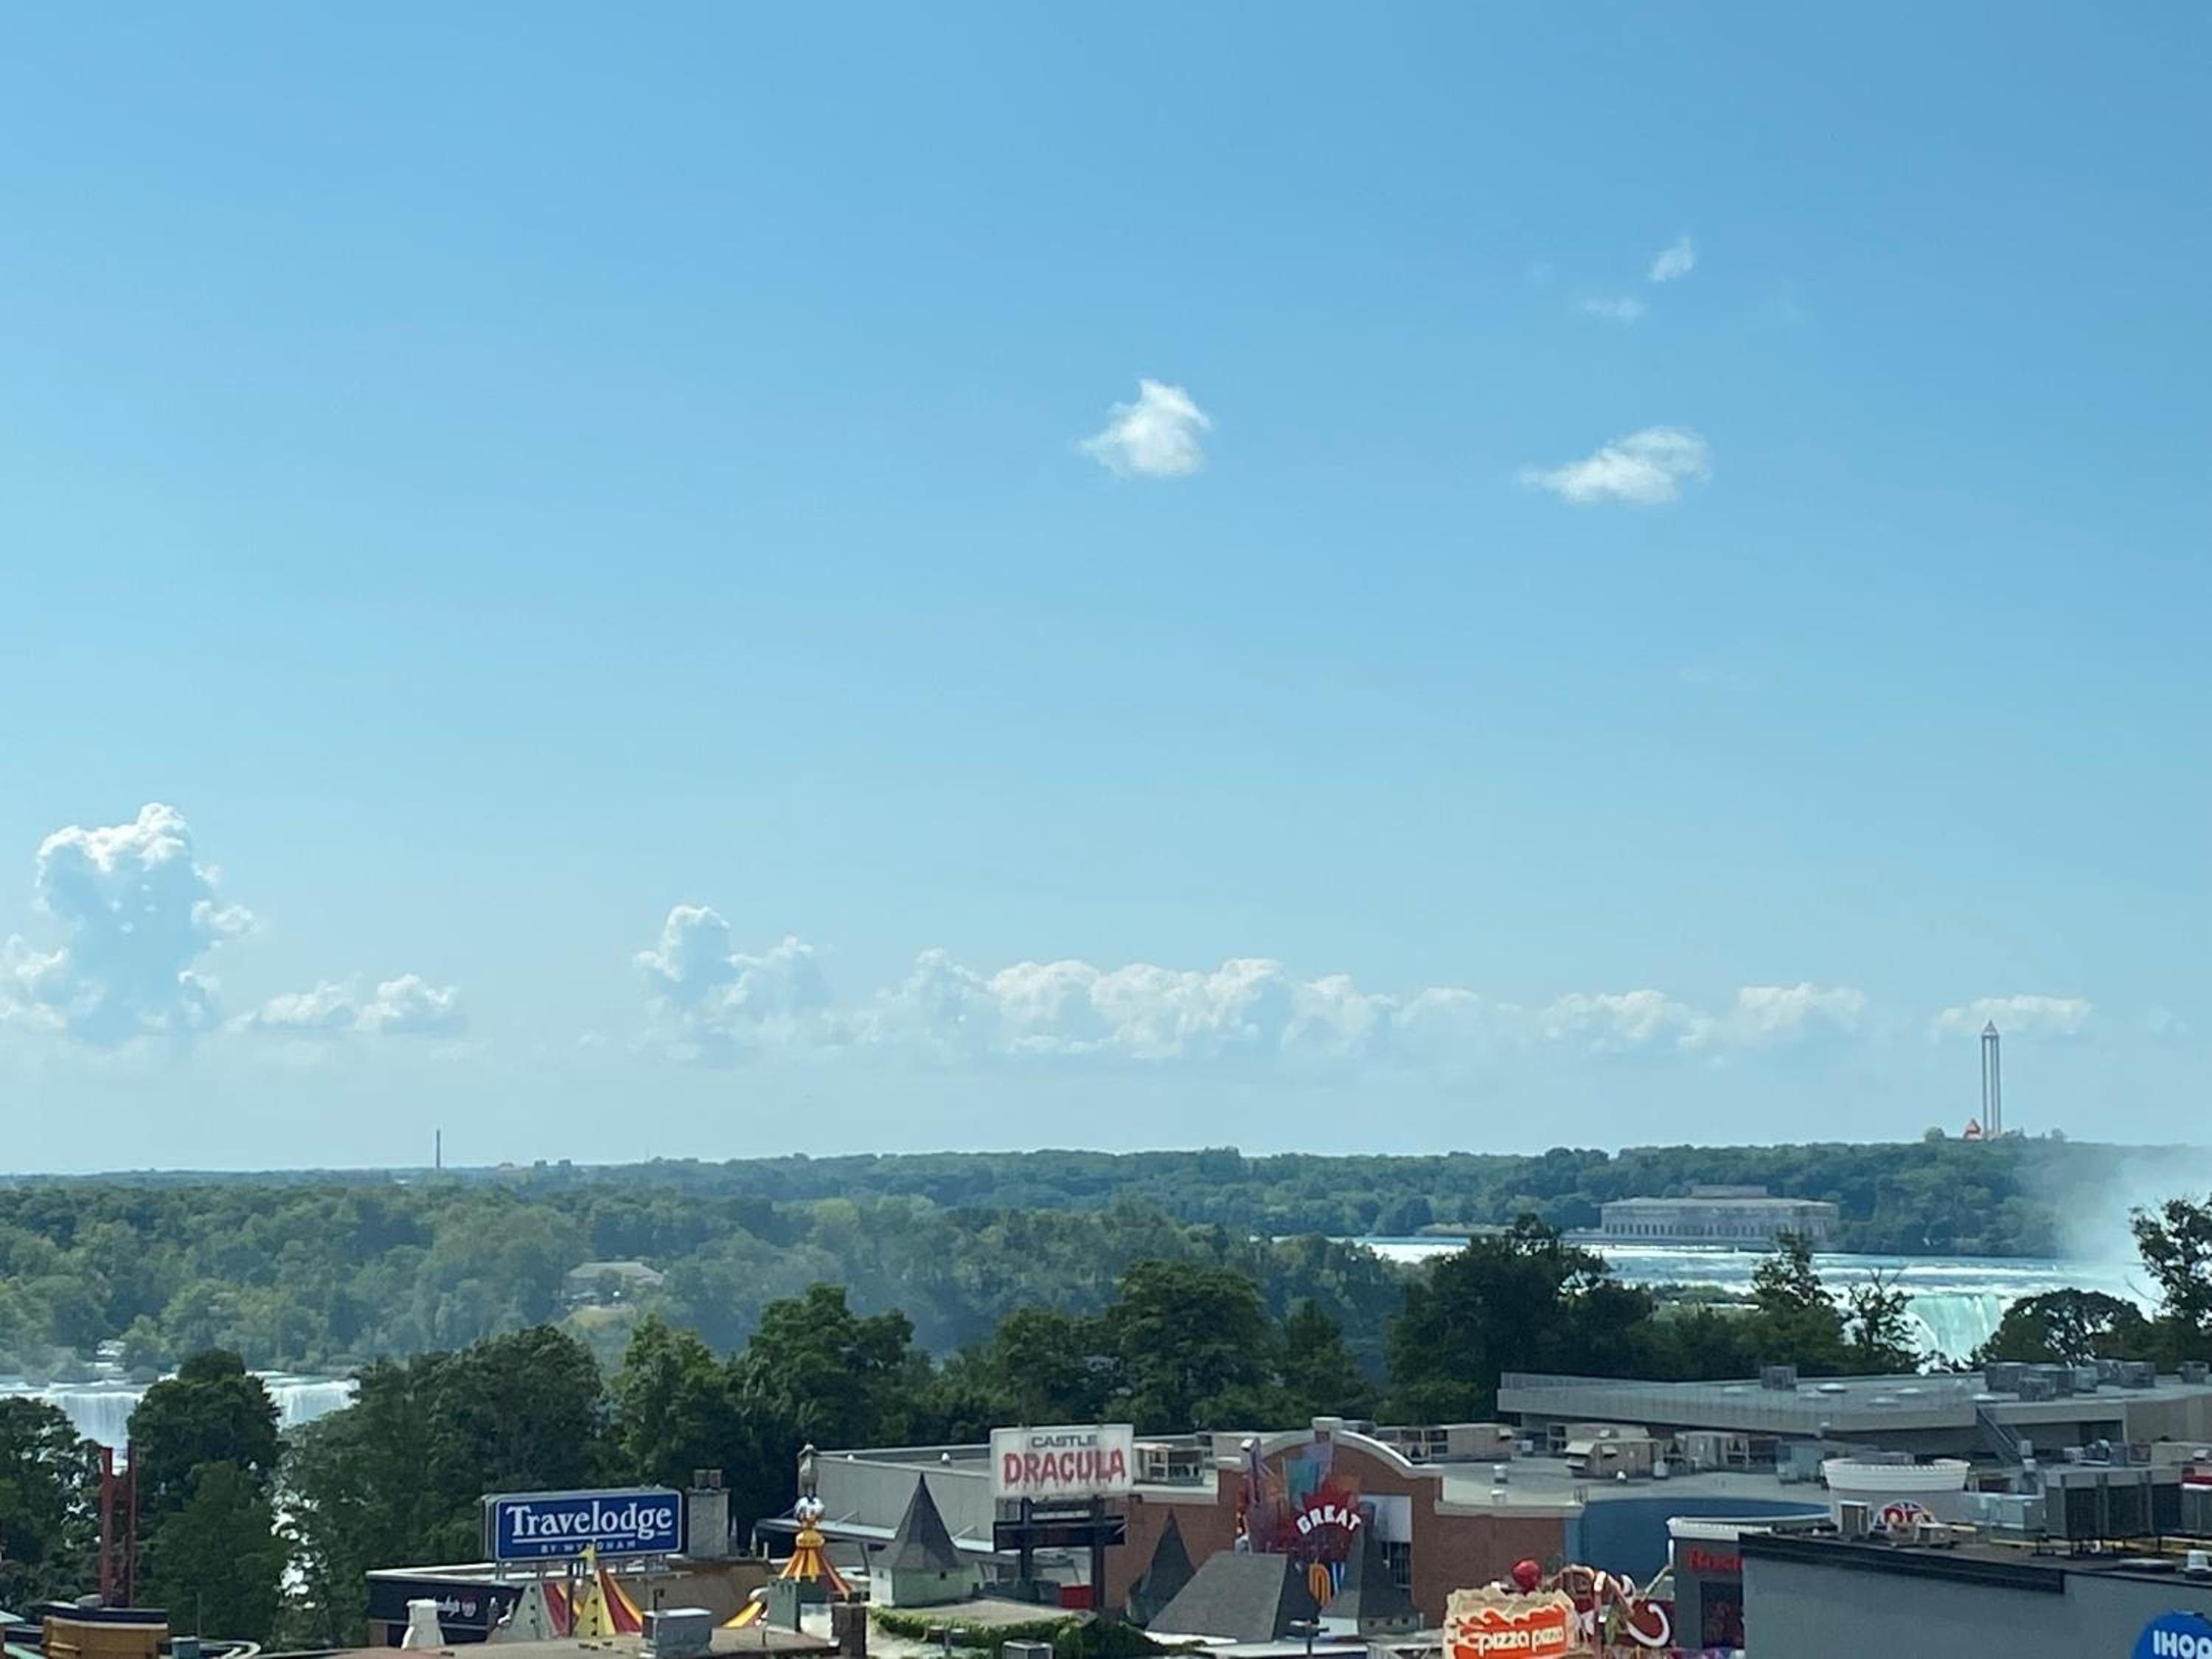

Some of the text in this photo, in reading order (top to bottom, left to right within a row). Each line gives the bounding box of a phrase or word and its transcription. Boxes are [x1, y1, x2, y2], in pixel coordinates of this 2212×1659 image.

[1032, 1435, 1098, 1447] CASTLE
[1004, 1448, 1126, 1487] DRACULA
[505, 1500, 672, 1540] Travelodge
[1296, 1504, 1362, 1534] GREAT
[540, 1545, 557, 1554] BY
[1478, 1630, 1530, 1658] pizza
